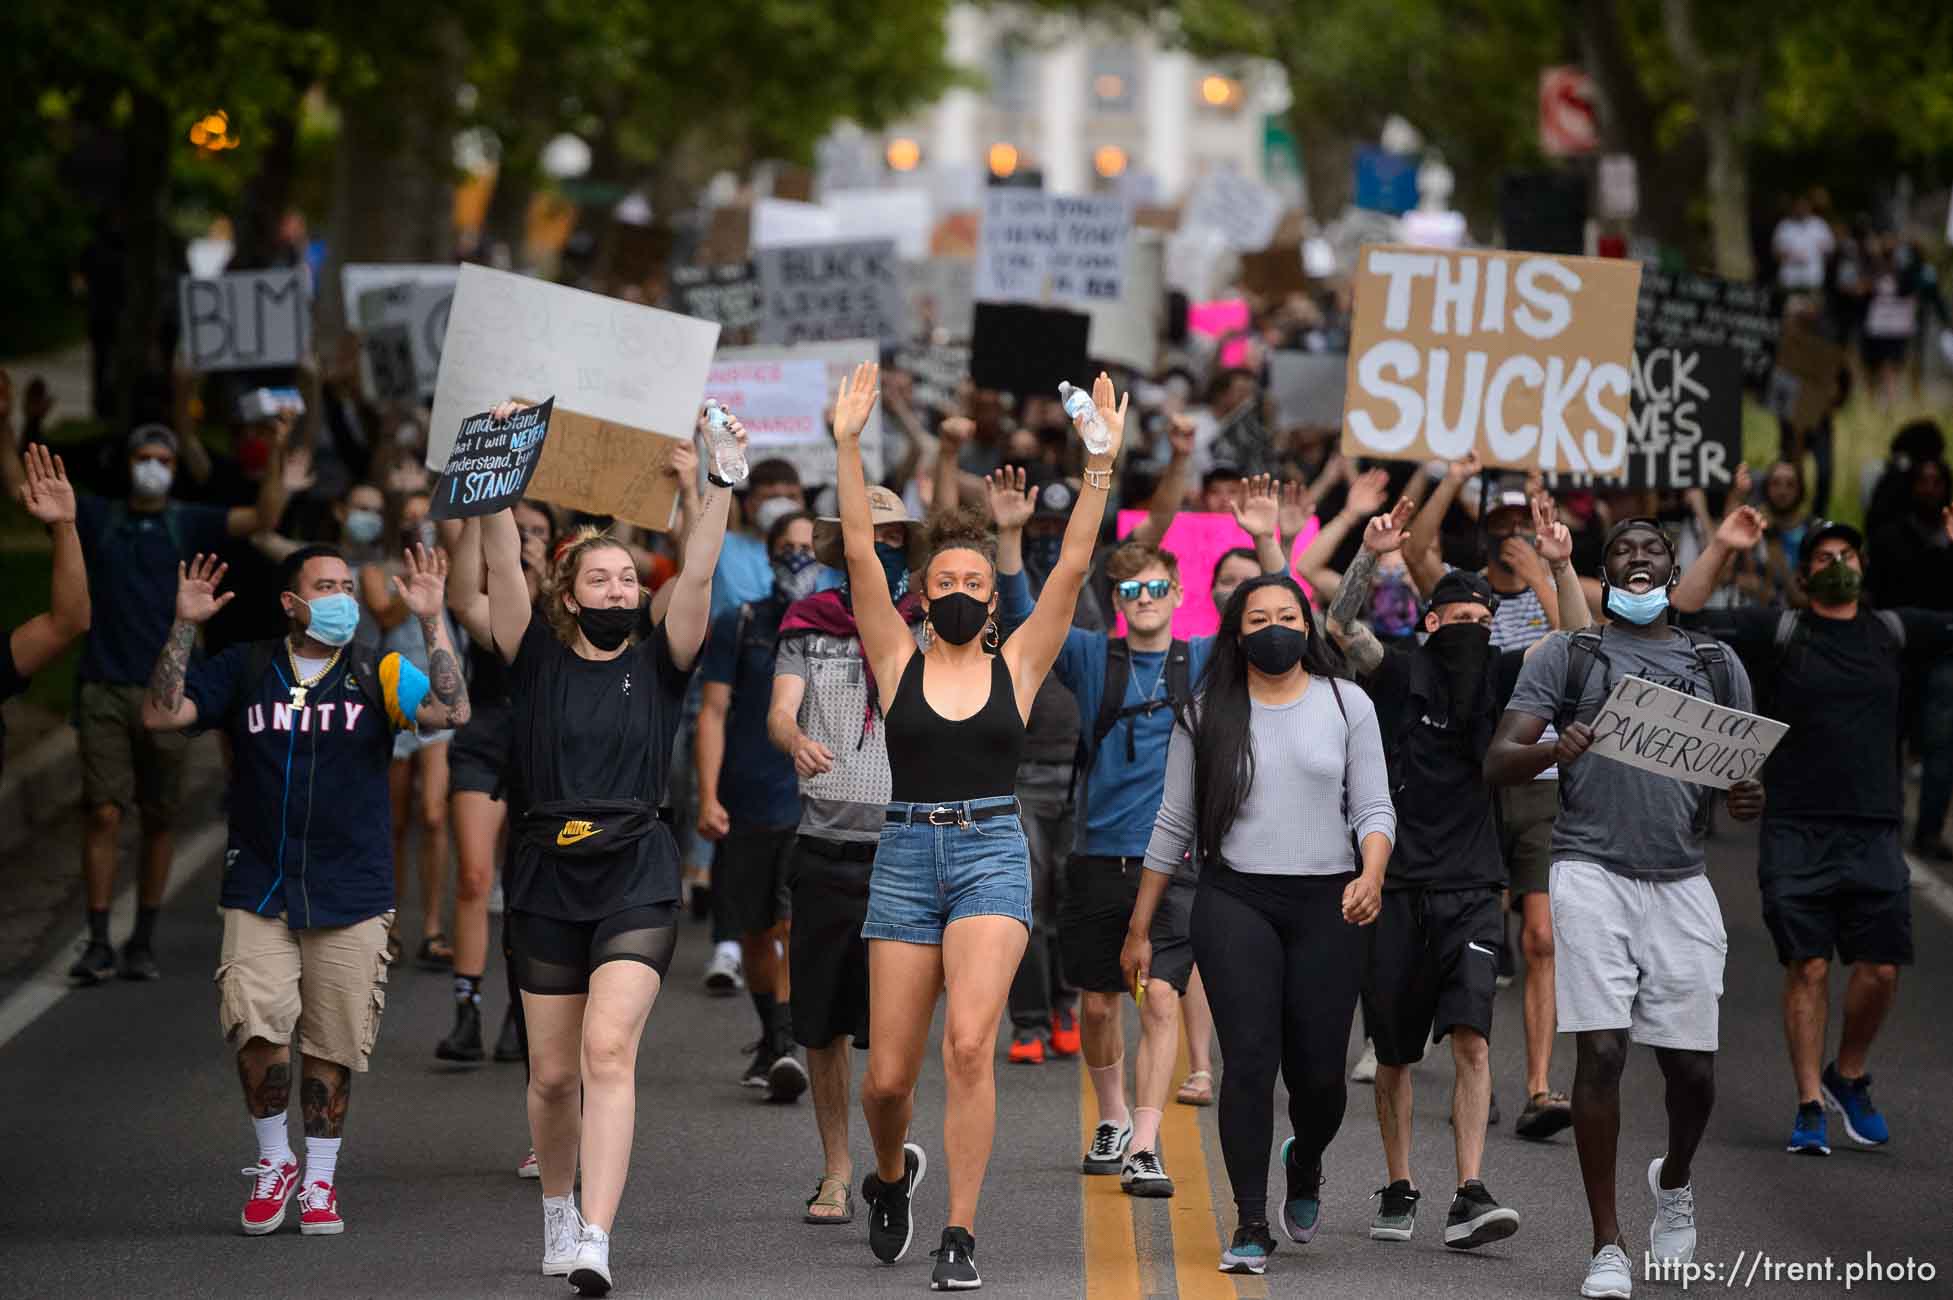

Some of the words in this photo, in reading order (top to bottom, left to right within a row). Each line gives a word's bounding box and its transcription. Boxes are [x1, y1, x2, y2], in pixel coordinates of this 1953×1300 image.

[782, 248, 894, 283] BLACK
[774, 286, 882, 319] LIVES
[1368, 250, 1582, 340] THIS
[187, 278, 299, 365] BLM
[1629, 347, 1711, 401] ACK
[1347, 339, 1631, 475] SUCKS
[1626, 401, 1702, 446] VES
[452, 438, 472, 456] hat
[475, 436, 482, 451] I
[484, 433, 507, 449] will
[509, 421, 545, 450] NEVER
[449, 477, 458, 504] I
[463, 465, 527, 505] STAND!
[248, 701, 366, 734] UNITY
[1701, 709, 1761, 745] LOOK
[1595, 710, 1768, 781] DANGEROUS?
[562, 820, 594, 835] NIKE
